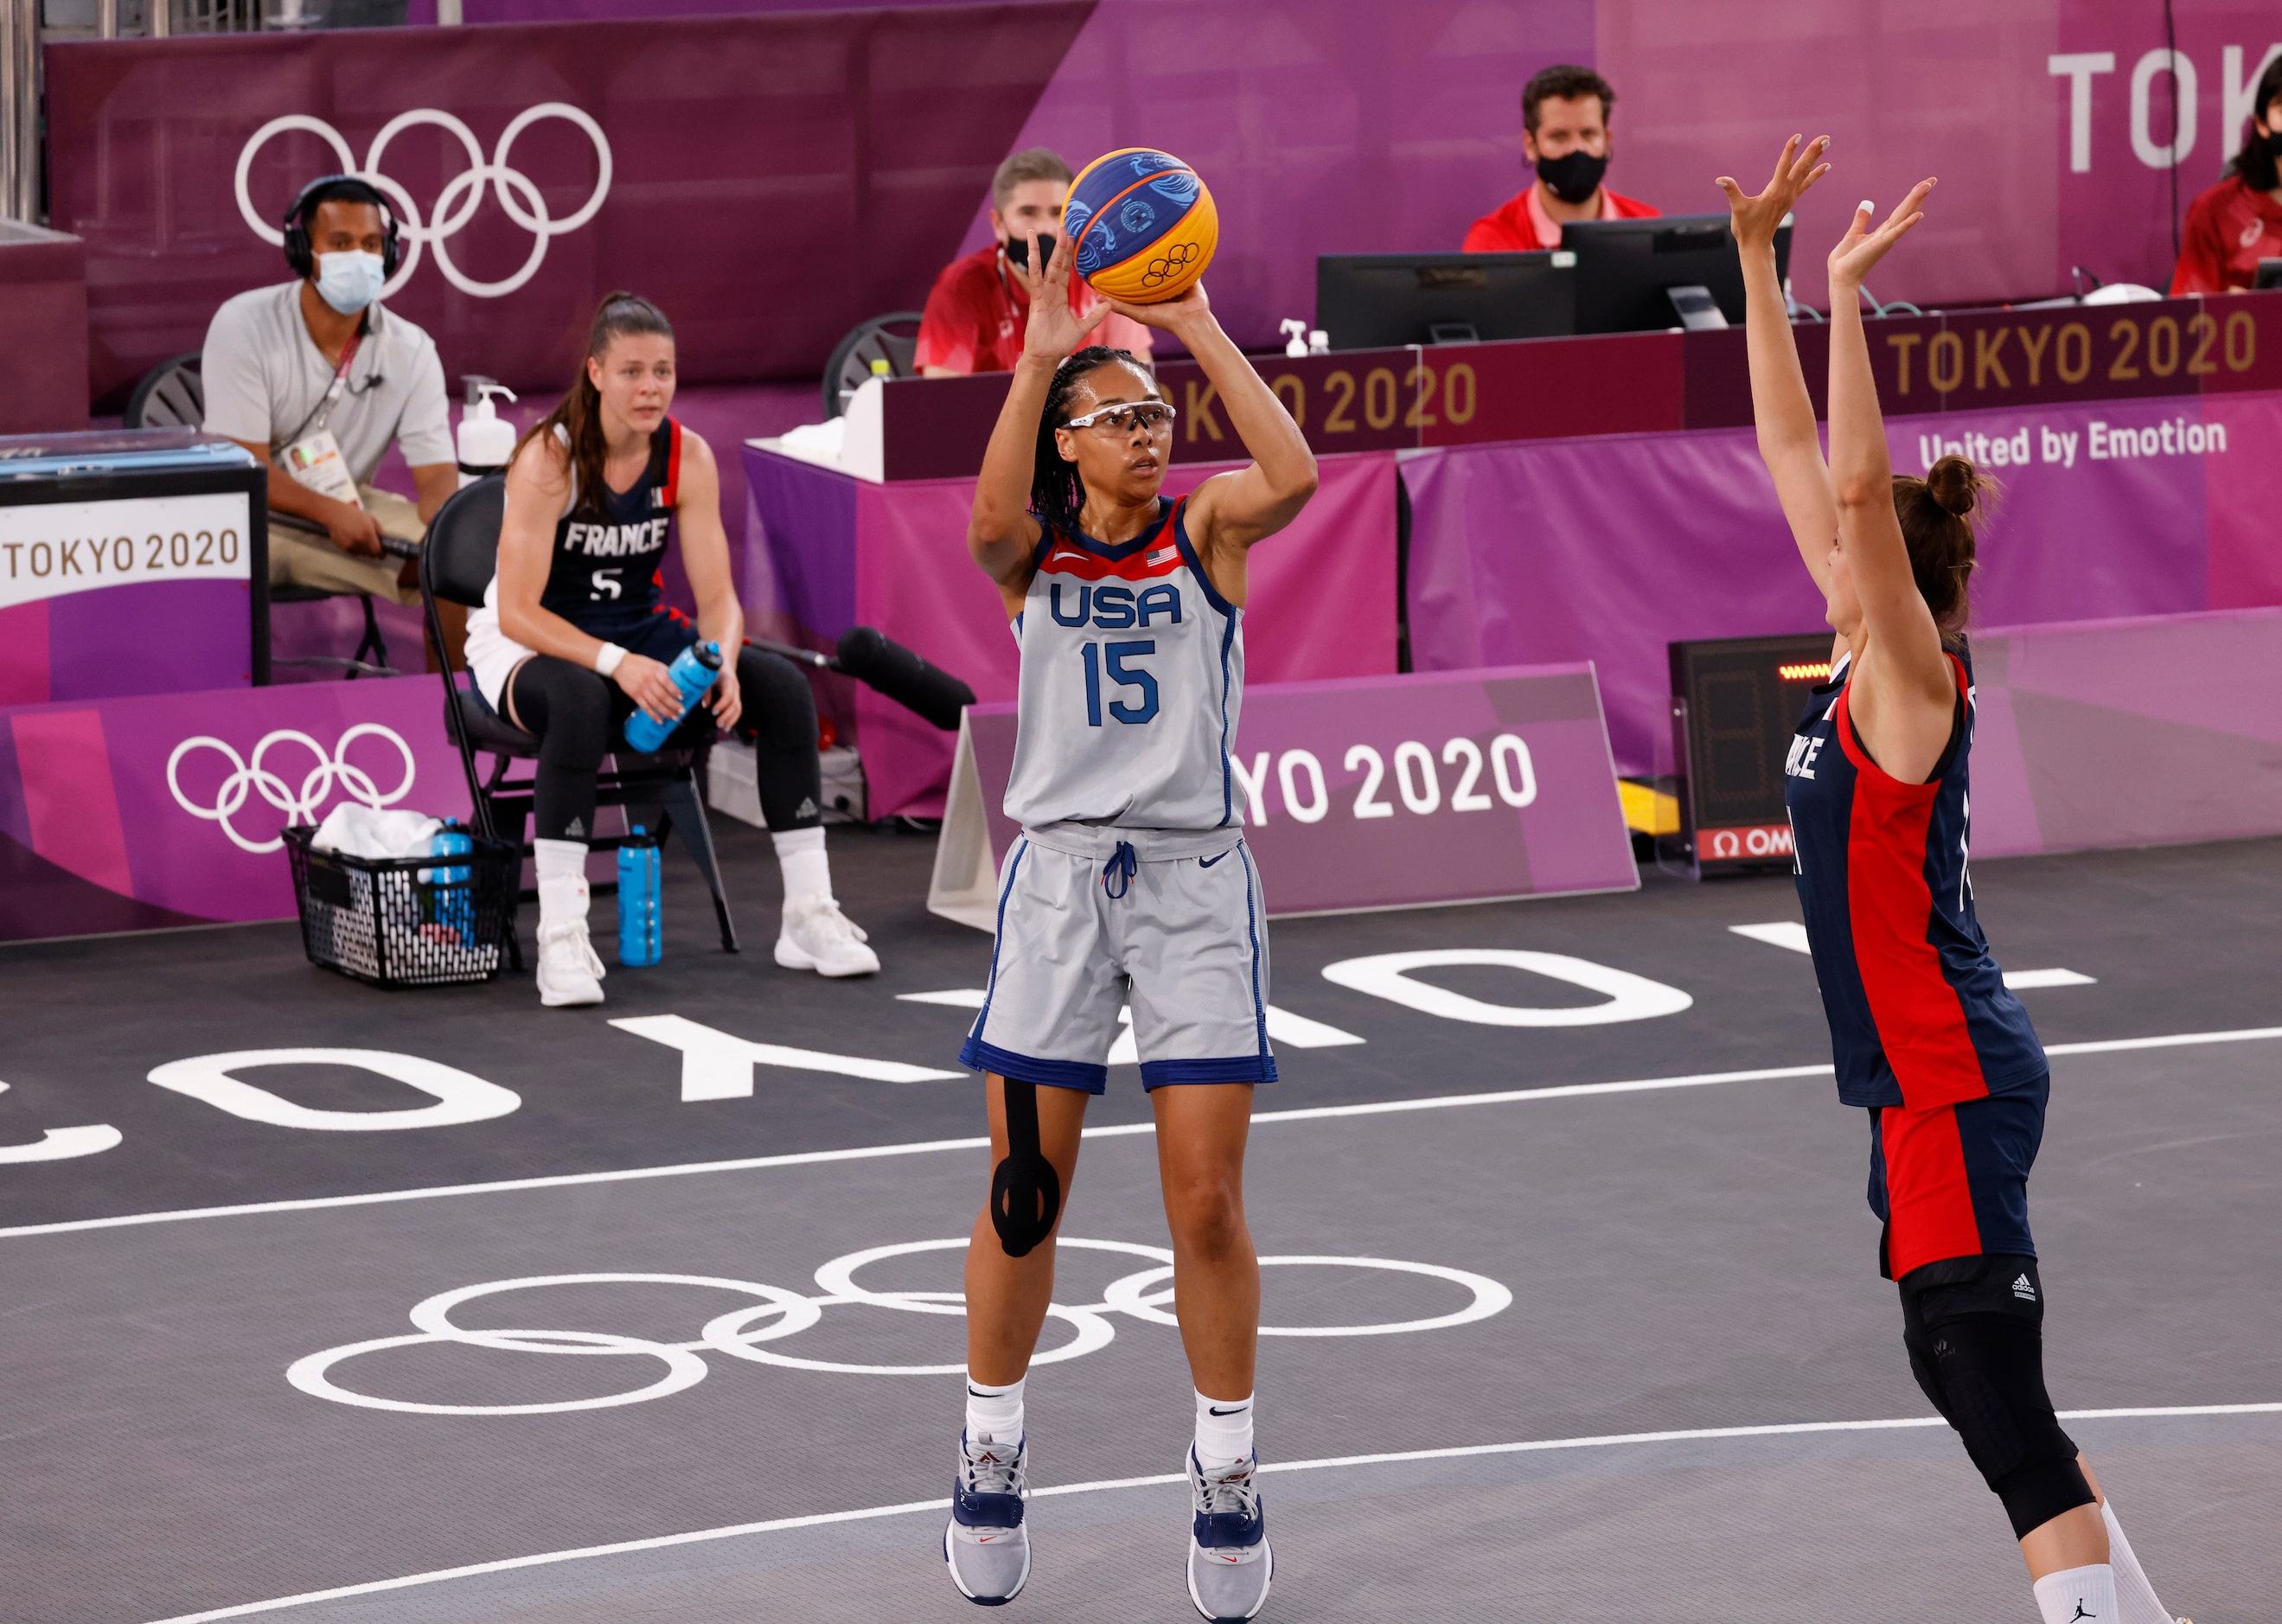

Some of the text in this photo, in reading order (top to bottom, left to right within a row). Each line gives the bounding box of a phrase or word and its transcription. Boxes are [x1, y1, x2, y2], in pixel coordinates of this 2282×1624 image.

[1887, 311, 2255, 395] TOKYO 2020
[1324, 363, 1476, 432] 2020
[2042, 425, 2078, 469] by
[2088, 418, 2227, 460] Emotion
[3, 529, 238, 578] TOKYO 2020
[564, 517, 669, 557] FRANCE
[590, 568, 623, 600] 5
[1051, 584, 1182, 629] USA
[1081, 640, 1160, 726] 15
[1345, 733, 1537, 819] 2020
[2011, 1283, 2035, 1294] adidas
